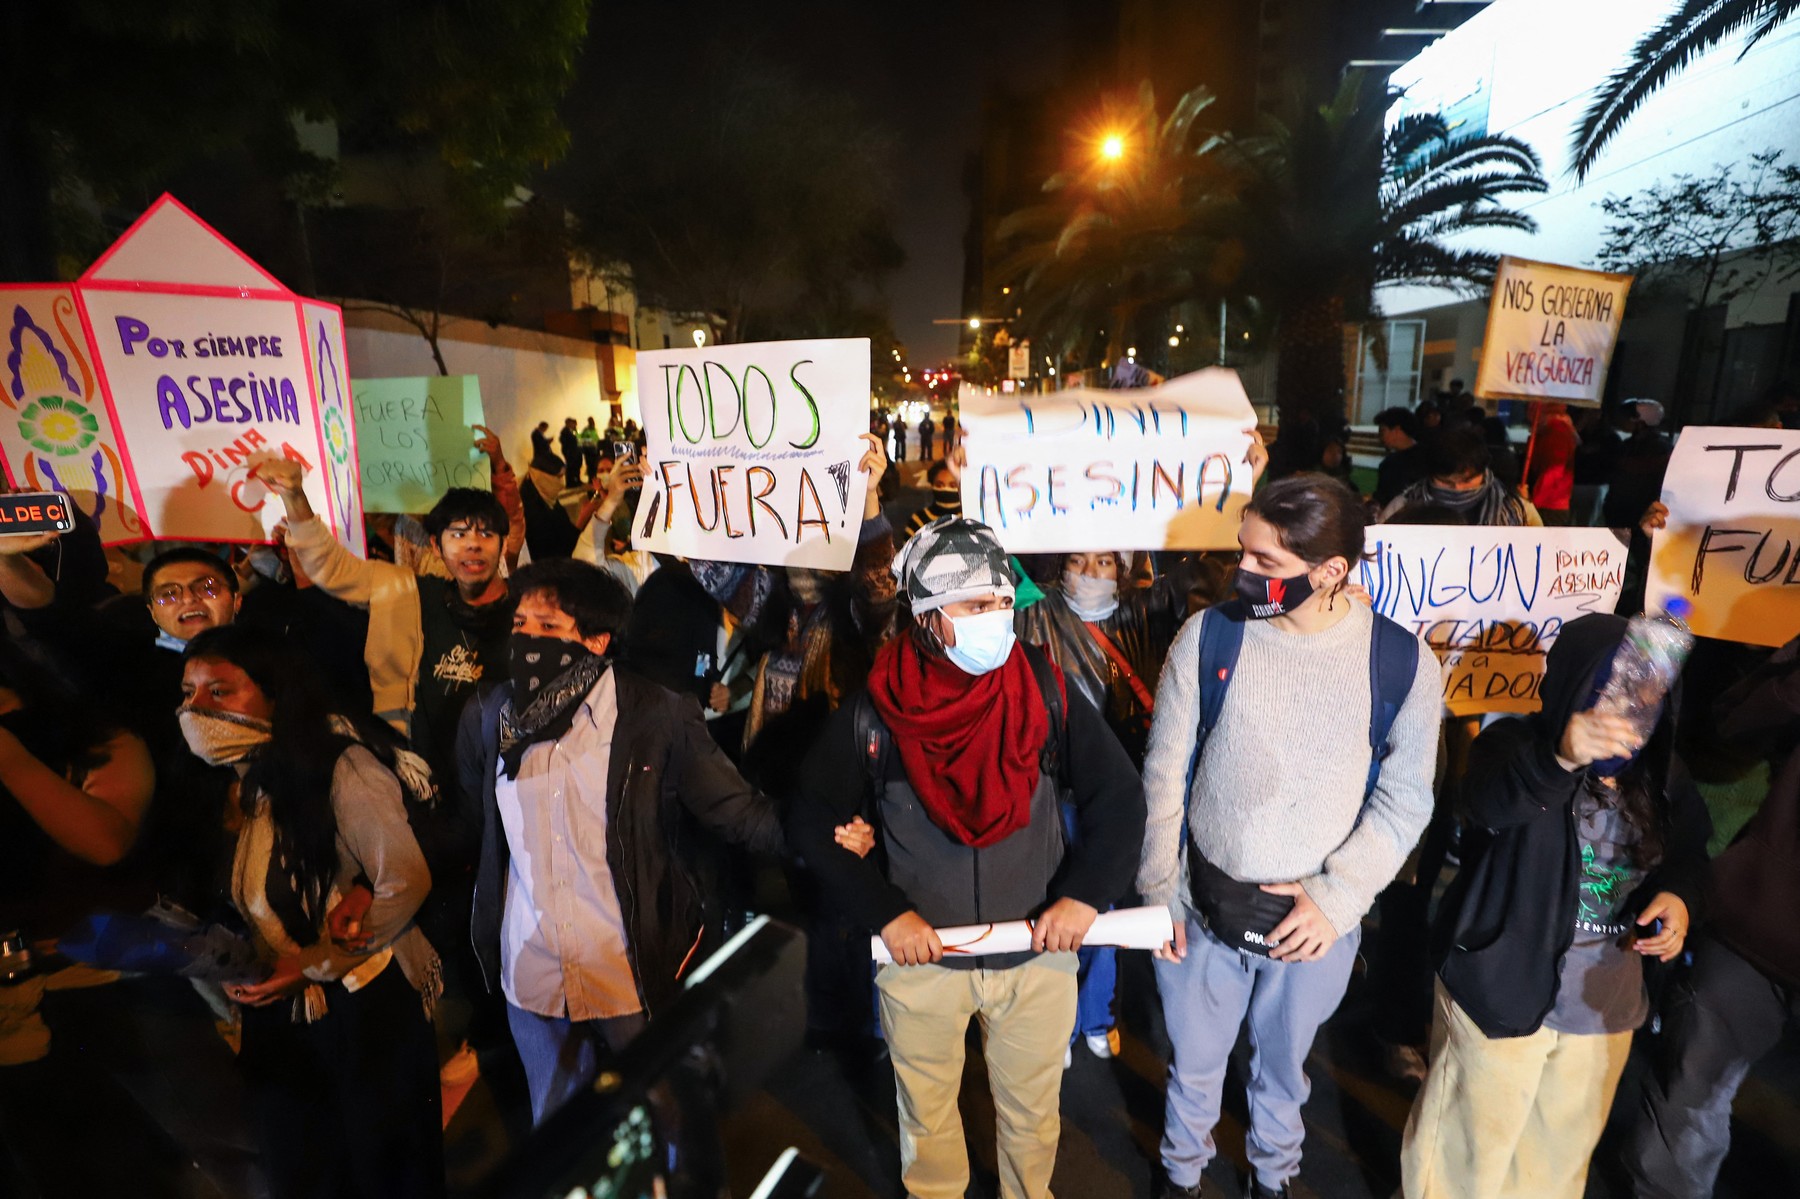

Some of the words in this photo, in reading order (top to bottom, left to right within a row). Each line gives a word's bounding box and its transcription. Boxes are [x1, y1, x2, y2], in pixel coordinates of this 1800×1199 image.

[1502, 278, 1534, 312] NOS
[1541, 284, 1613, 323] GOBIERNA
[1540, 320, 1565, 346] LA
[1506, 349, 1594, 386] VERGÜENZA
[659, 360, 821, 450] TODOS
[379, 426, 429, 450] LOS
[362, 459, 487, 490] ORRUPTOS
[980, 453, 1232, 528] ASESINA
[15, 505, 43, 522] DE
[641, 460, 850, 544] ¡FUERA!
